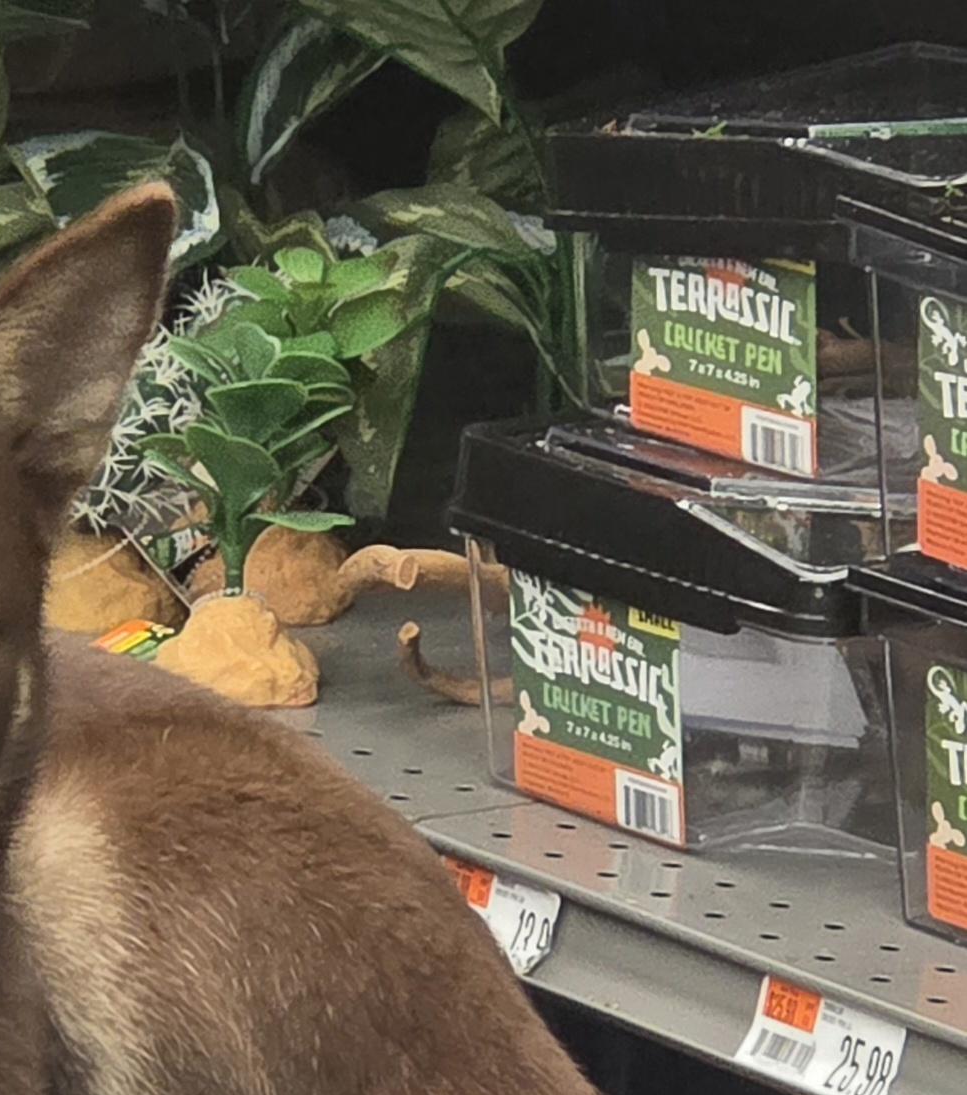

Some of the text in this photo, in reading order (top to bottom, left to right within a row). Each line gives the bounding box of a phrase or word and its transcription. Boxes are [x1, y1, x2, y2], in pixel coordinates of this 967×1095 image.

[648, 267, 802, 346] TERRASSIC
[664, 320, 782, 376] CRICKET PEN
[543, 682, 651, 739] CRICKET PEN
